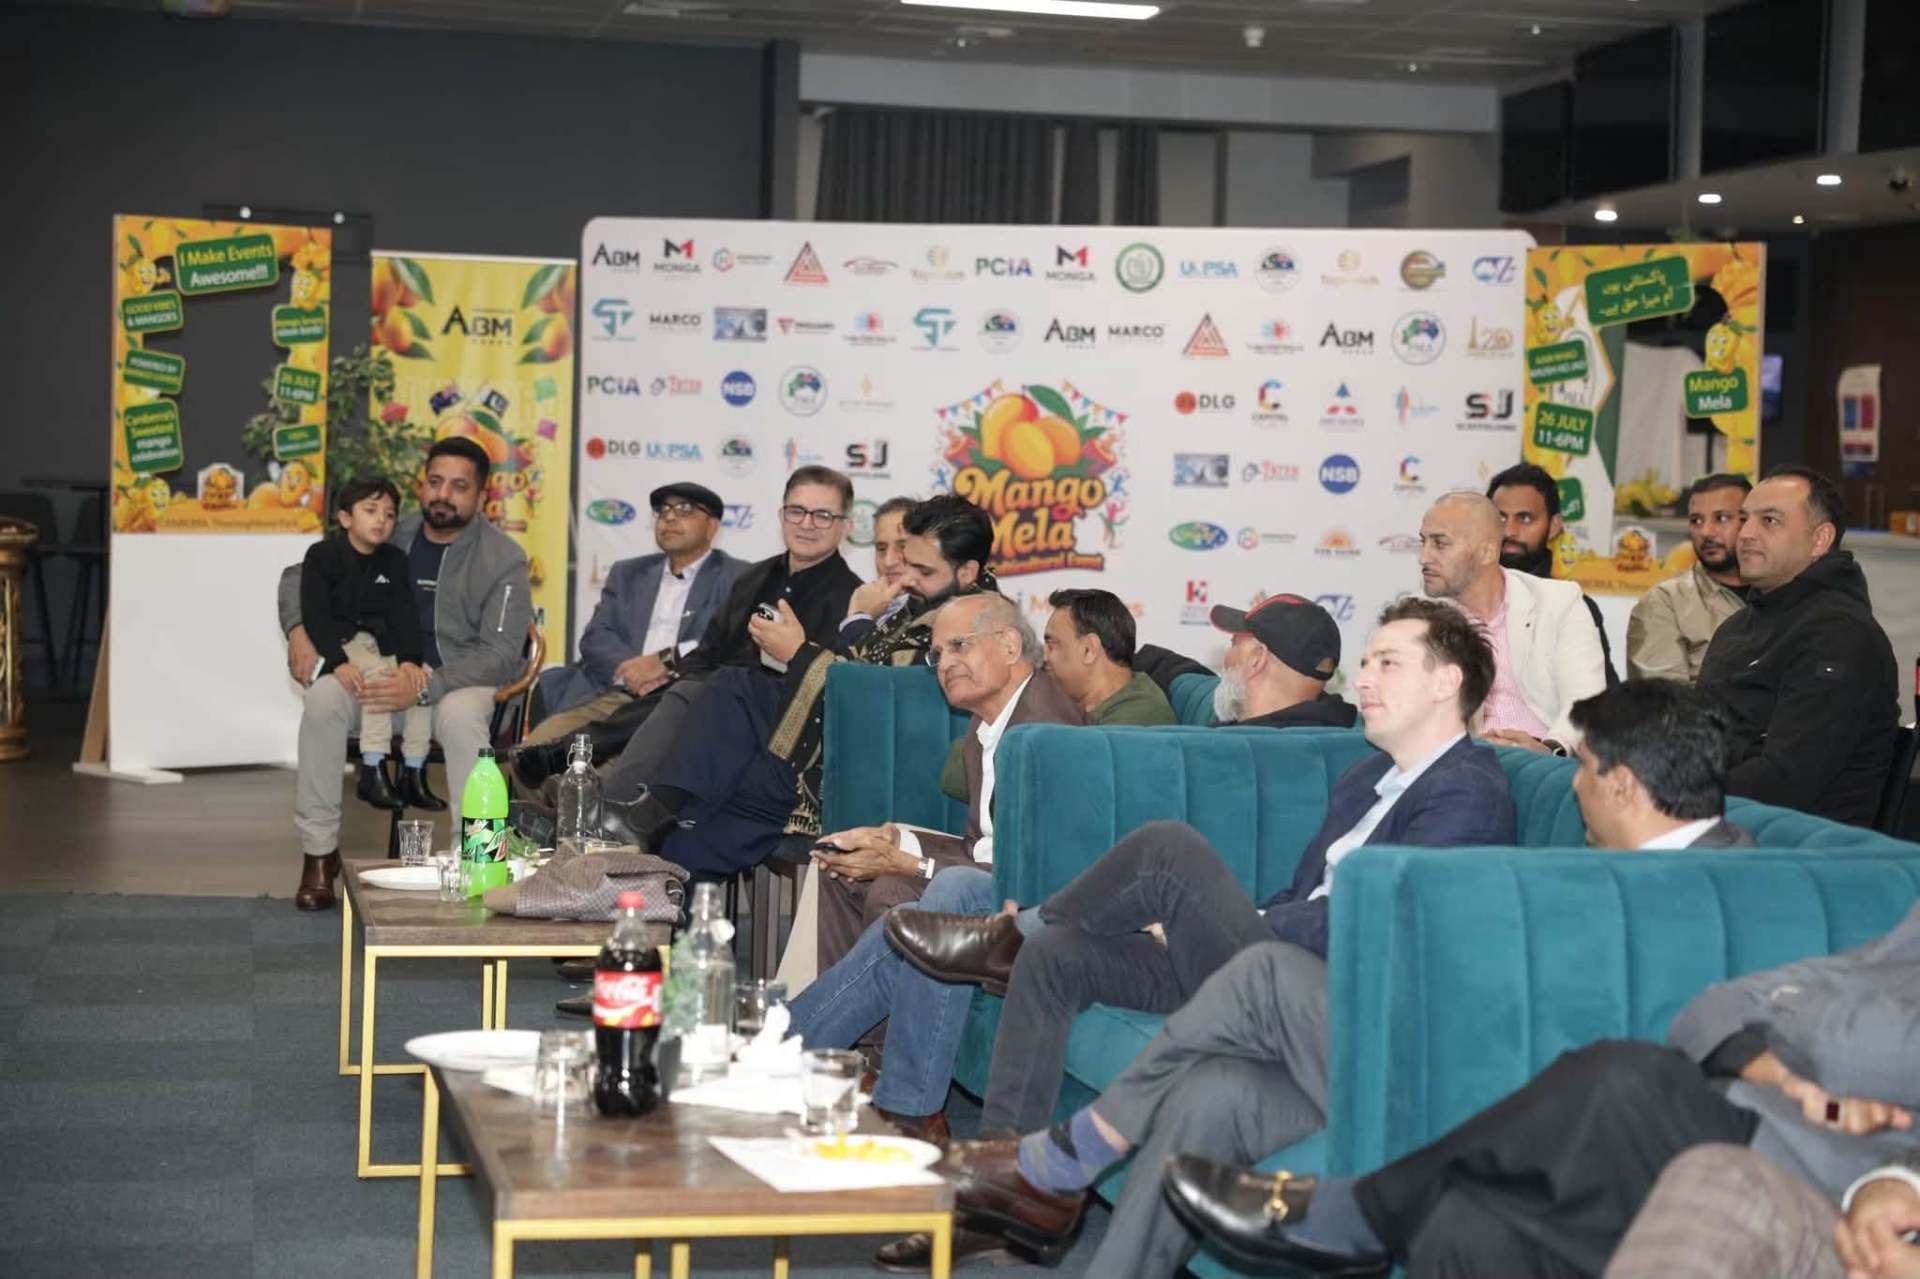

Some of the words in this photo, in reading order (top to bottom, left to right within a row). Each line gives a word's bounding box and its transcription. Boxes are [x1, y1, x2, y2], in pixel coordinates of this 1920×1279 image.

[188, 247, 226, 266] Make
[227, 244, 273, 261] Events
[441, 306, 512, 337] ABM
[649, 313, 701, 326] MARCO
[1109, 324, 1164, 338] MARCO
[1689, 376, 1738, 394] Mango
[1199, 394, 1236, 409] DLG
[1698, 394, 1733, 412] Mela
[1539, 408, 1556, 427] 26
[1557, 413, 1588, 432] JULY
[608, 439, 640, 456] DLG
[953, 466, 1107, 521] Mango
